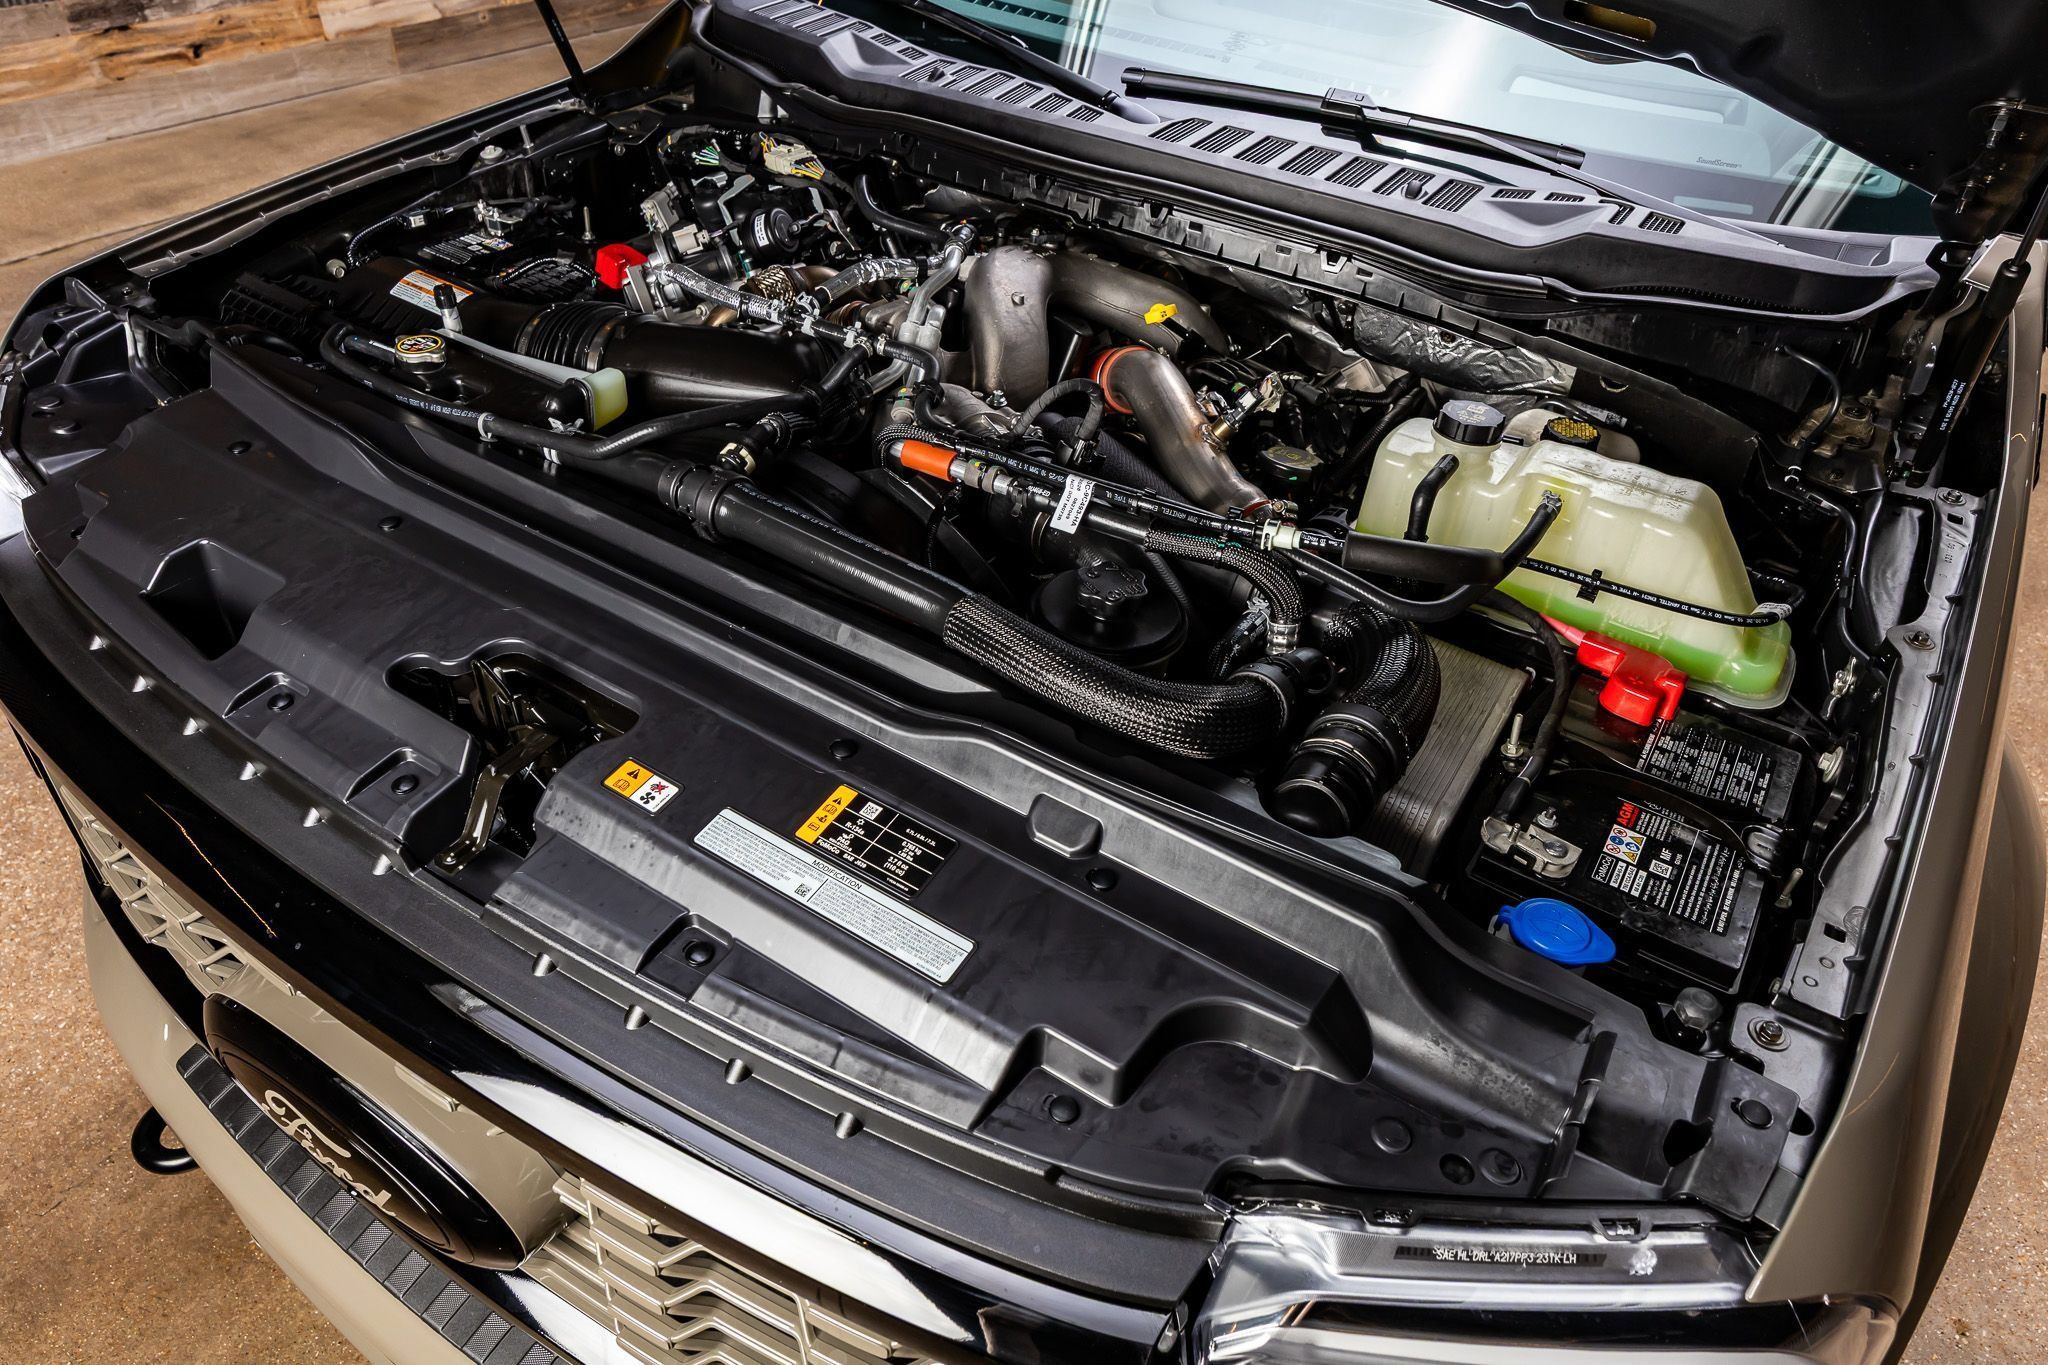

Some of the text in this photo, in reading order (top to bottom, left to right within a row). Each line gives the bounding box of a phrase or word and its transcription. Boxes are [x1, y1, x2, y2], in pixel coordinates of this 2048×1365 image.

[1615, 801, 1634, 826] AGM
[844, 821, 866, 835] R-134a
[815, 838, 841, 855] FoMoCo
[836, 836, 850, 846] PAG
[810, 859, 863, 890] MODIFICATION
[1595, 854, 1612, 881] FoMoCo
[262, 1089, 397, 1217] Ford
[1436, 1251, 1455, 1261] SAE
[1458, 1252, 1470, 1262] HL
[1473, 1252, 1491, 1263] DRL
[1564, 1253, 1577, 1264] LH
